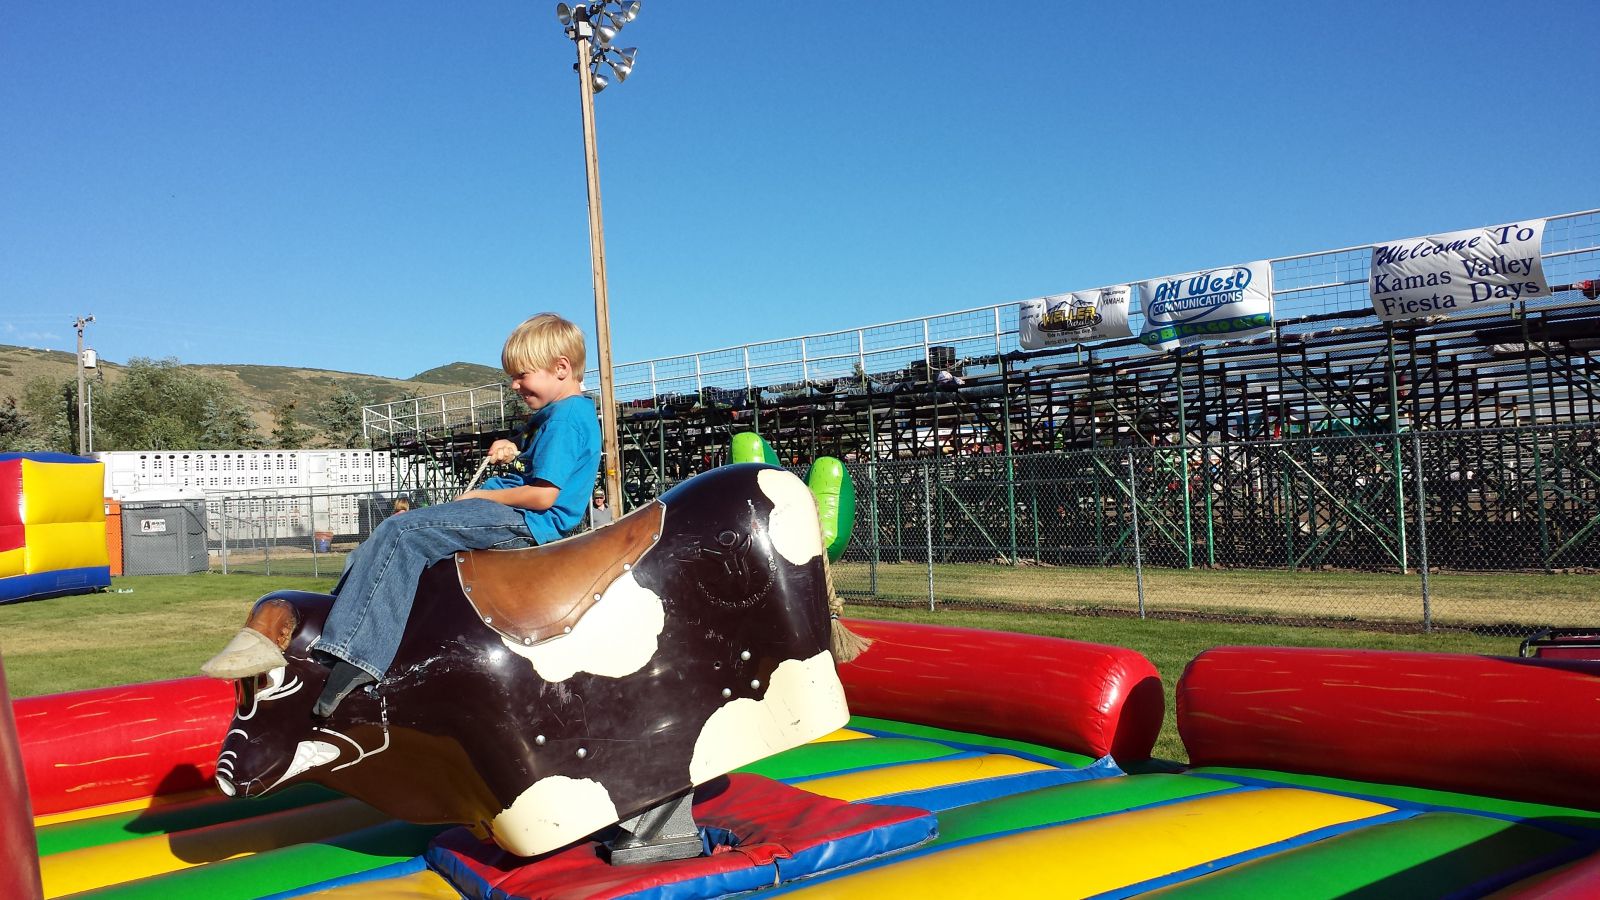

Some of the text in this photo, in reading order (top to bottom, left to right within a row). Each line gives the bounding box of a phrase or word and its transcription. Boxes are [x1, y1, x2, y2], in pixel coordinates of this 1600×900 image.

[1376, 224, 1534, 266] Welcome To
[1154, 271, 1244, 302] All West
[1374, 255, 1534, 295] Kamas Valley
[1153, 291, 1243, 315] COMMUNICATIONS
[1382, 281, 1540, 316] Fiesta Days
[1042, 306, 1097, 326] WELLER
